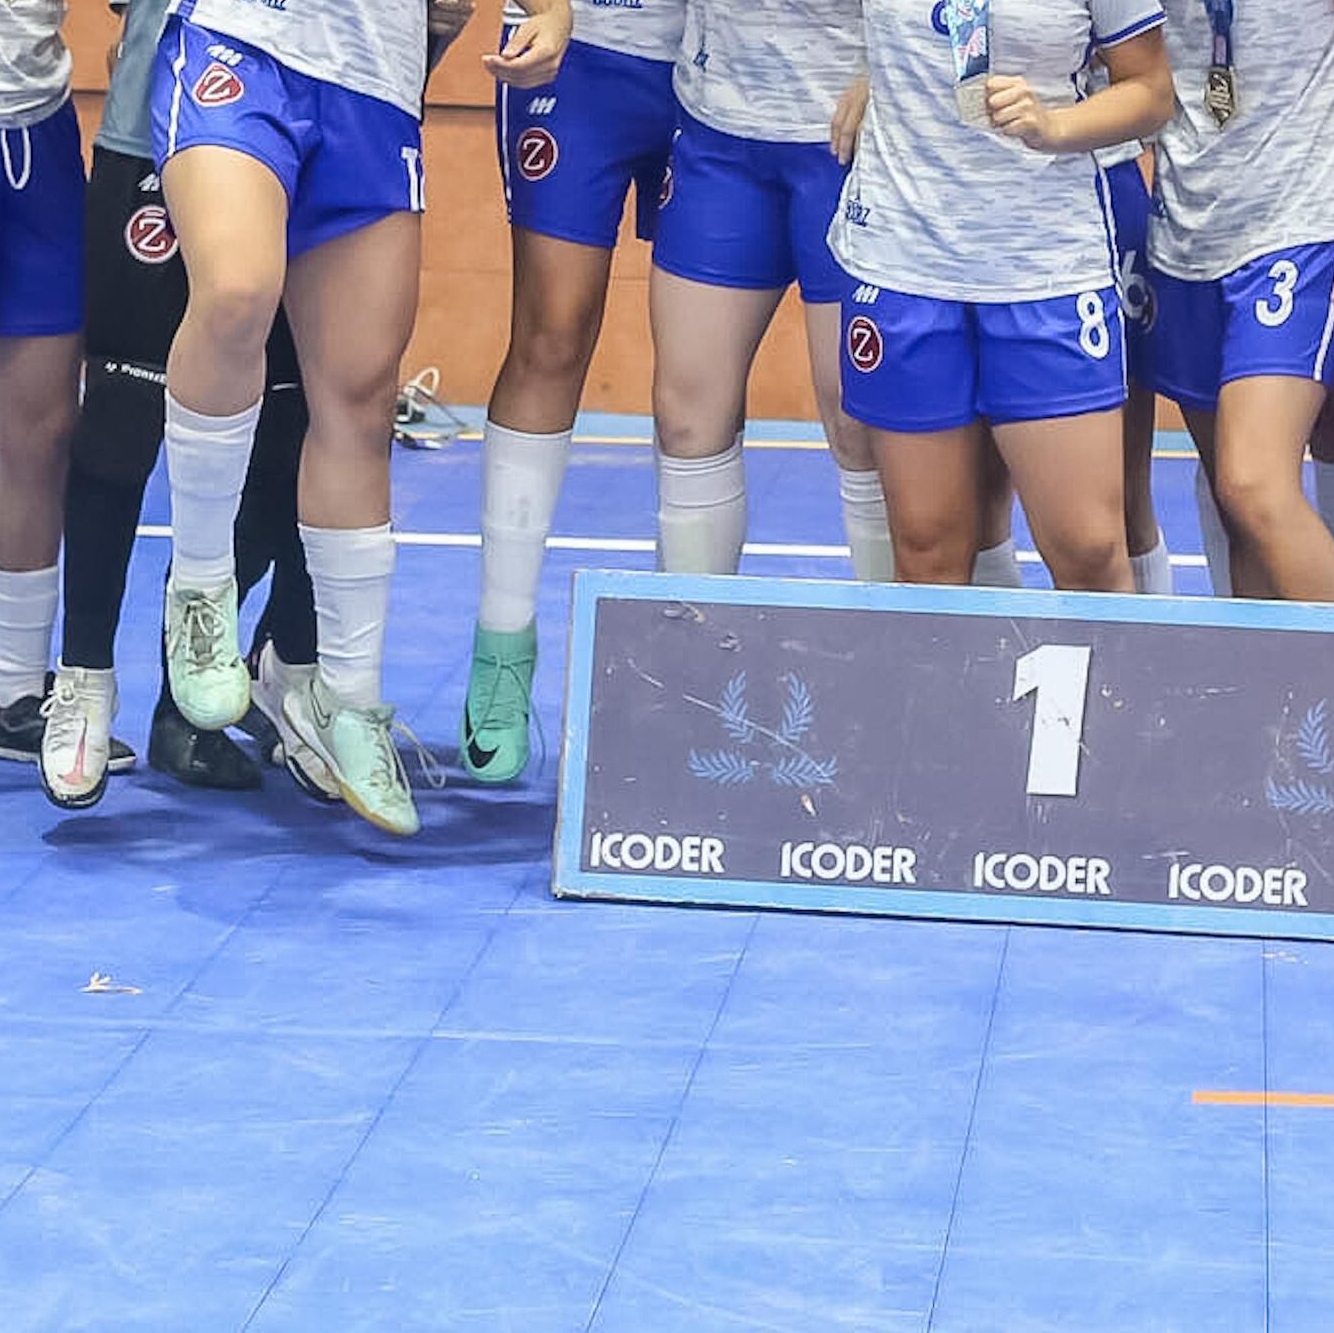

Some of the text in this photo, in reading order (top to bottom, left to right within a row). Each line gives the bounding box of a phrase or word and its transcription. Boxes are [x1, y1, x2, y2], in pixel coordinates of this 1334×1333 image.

[523, 138, 546, 170] Z
[139, 218, 166, 253] Z
[1076, 290, 1109, 360] 8
[1255, 259, 1298, 326] 3
[853, 328, 874, 361] Z
[1012, 644, 1091, 796] 1
[589, 832, 725, 874] ICODER
[780, 841, 916, 884] ICODER
[973, 851, 1111, 896] ICODER
[1167, 863, 1308, 907] ICODER
